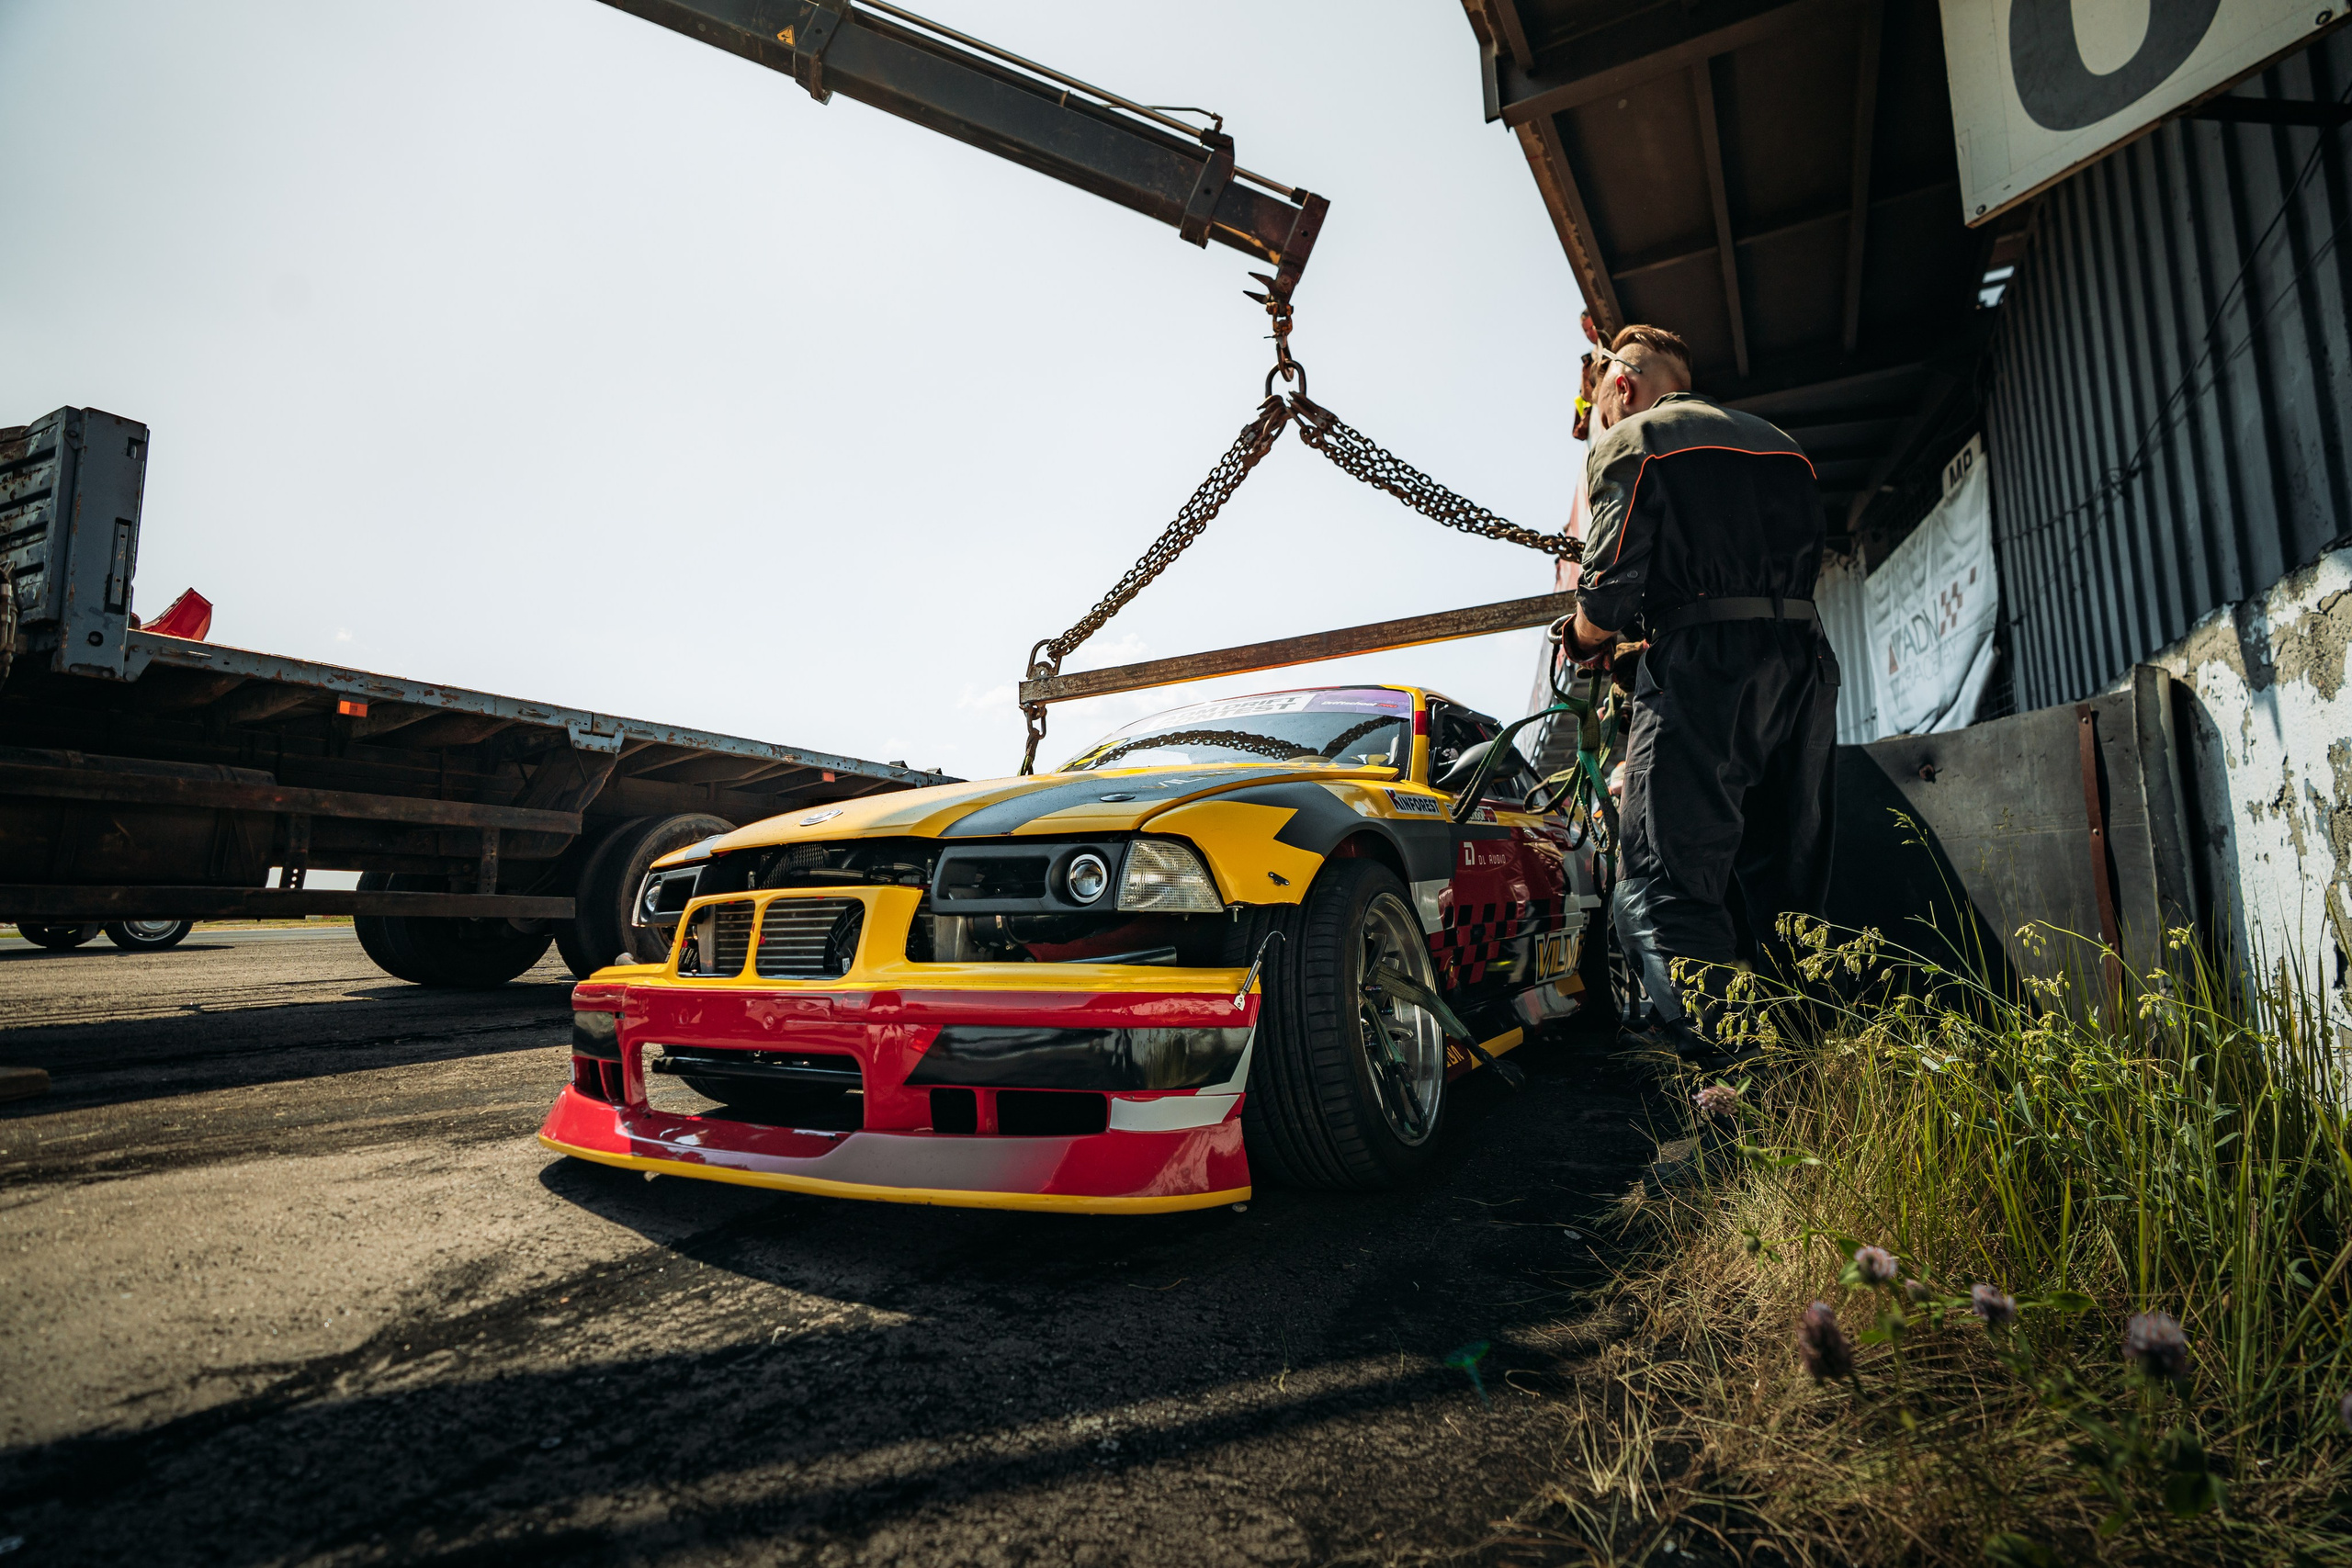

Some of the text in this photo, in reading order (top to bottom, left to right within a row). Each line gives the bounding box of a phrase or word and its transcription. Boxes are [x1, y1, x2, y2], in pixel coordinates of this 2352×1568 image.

[1221, 695, 1302, 712] DRIFT
[1385, 789, 1441, 813] KINFOREST
[1488, 853, 1507, 864] AUDIO
